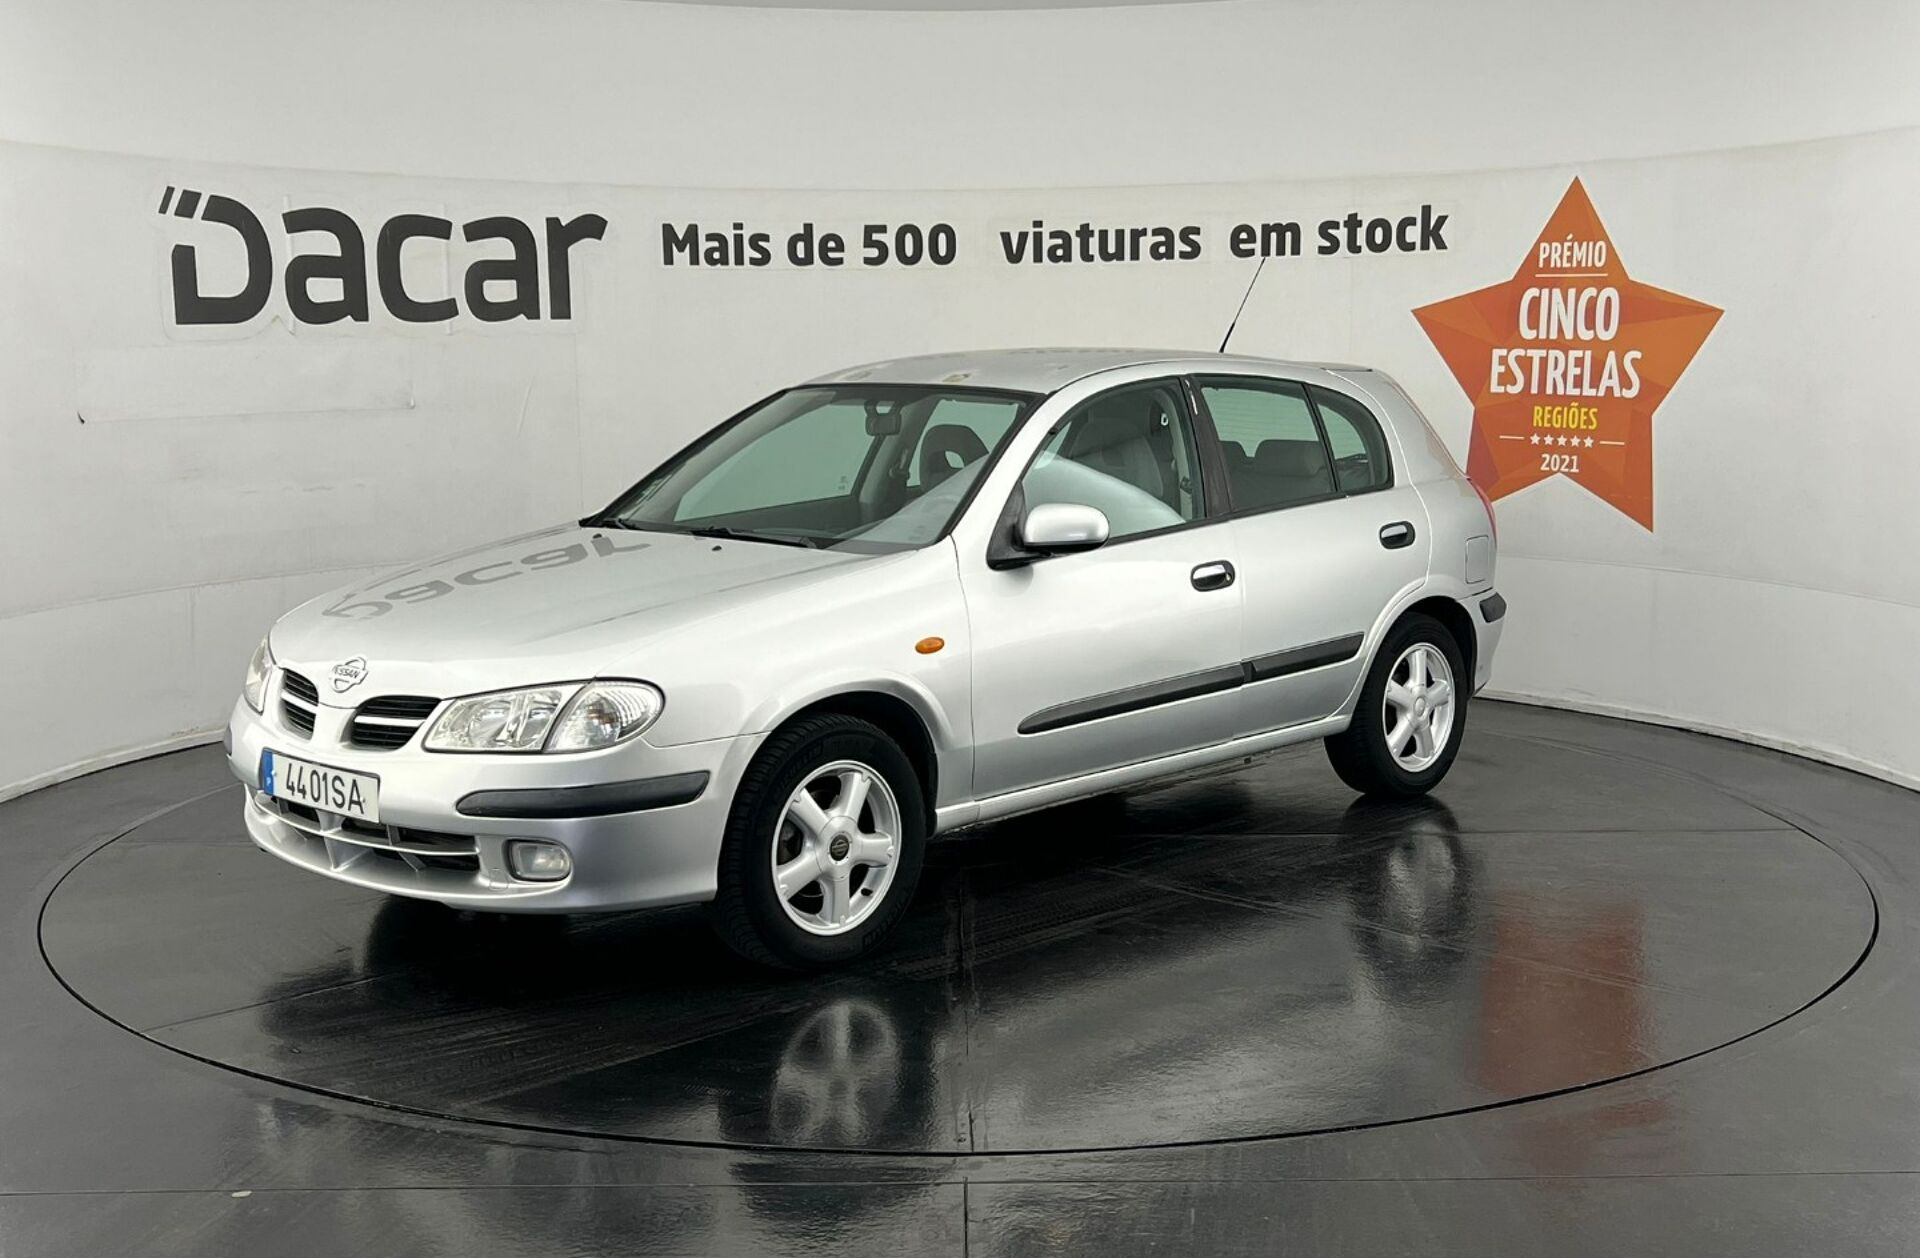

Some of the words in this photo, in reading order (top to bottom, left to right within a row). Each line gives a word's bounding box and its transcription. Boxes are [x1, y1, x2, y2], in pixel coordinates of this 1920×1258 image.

[159, 186, 608, 325] Dacar
[662, 223, 771, 266] Mais
[788, 223, 844, 266] de
[863, 224, 956, 266] 500
[1000, 221, 1201, 264] viaturas
[1230, 222, 1300, 257] em
[1318, 205, 1448, 255] stock
[1538, 234, 1607, 268] PRÉMIO
[1519, 287, 1620, 341] CINCO
[1490, 348, 1642, 398] ESTRELAS
[1533, 402, 1598, 430] REGIÕES
[1540, 453, 1580, 473] 2021
